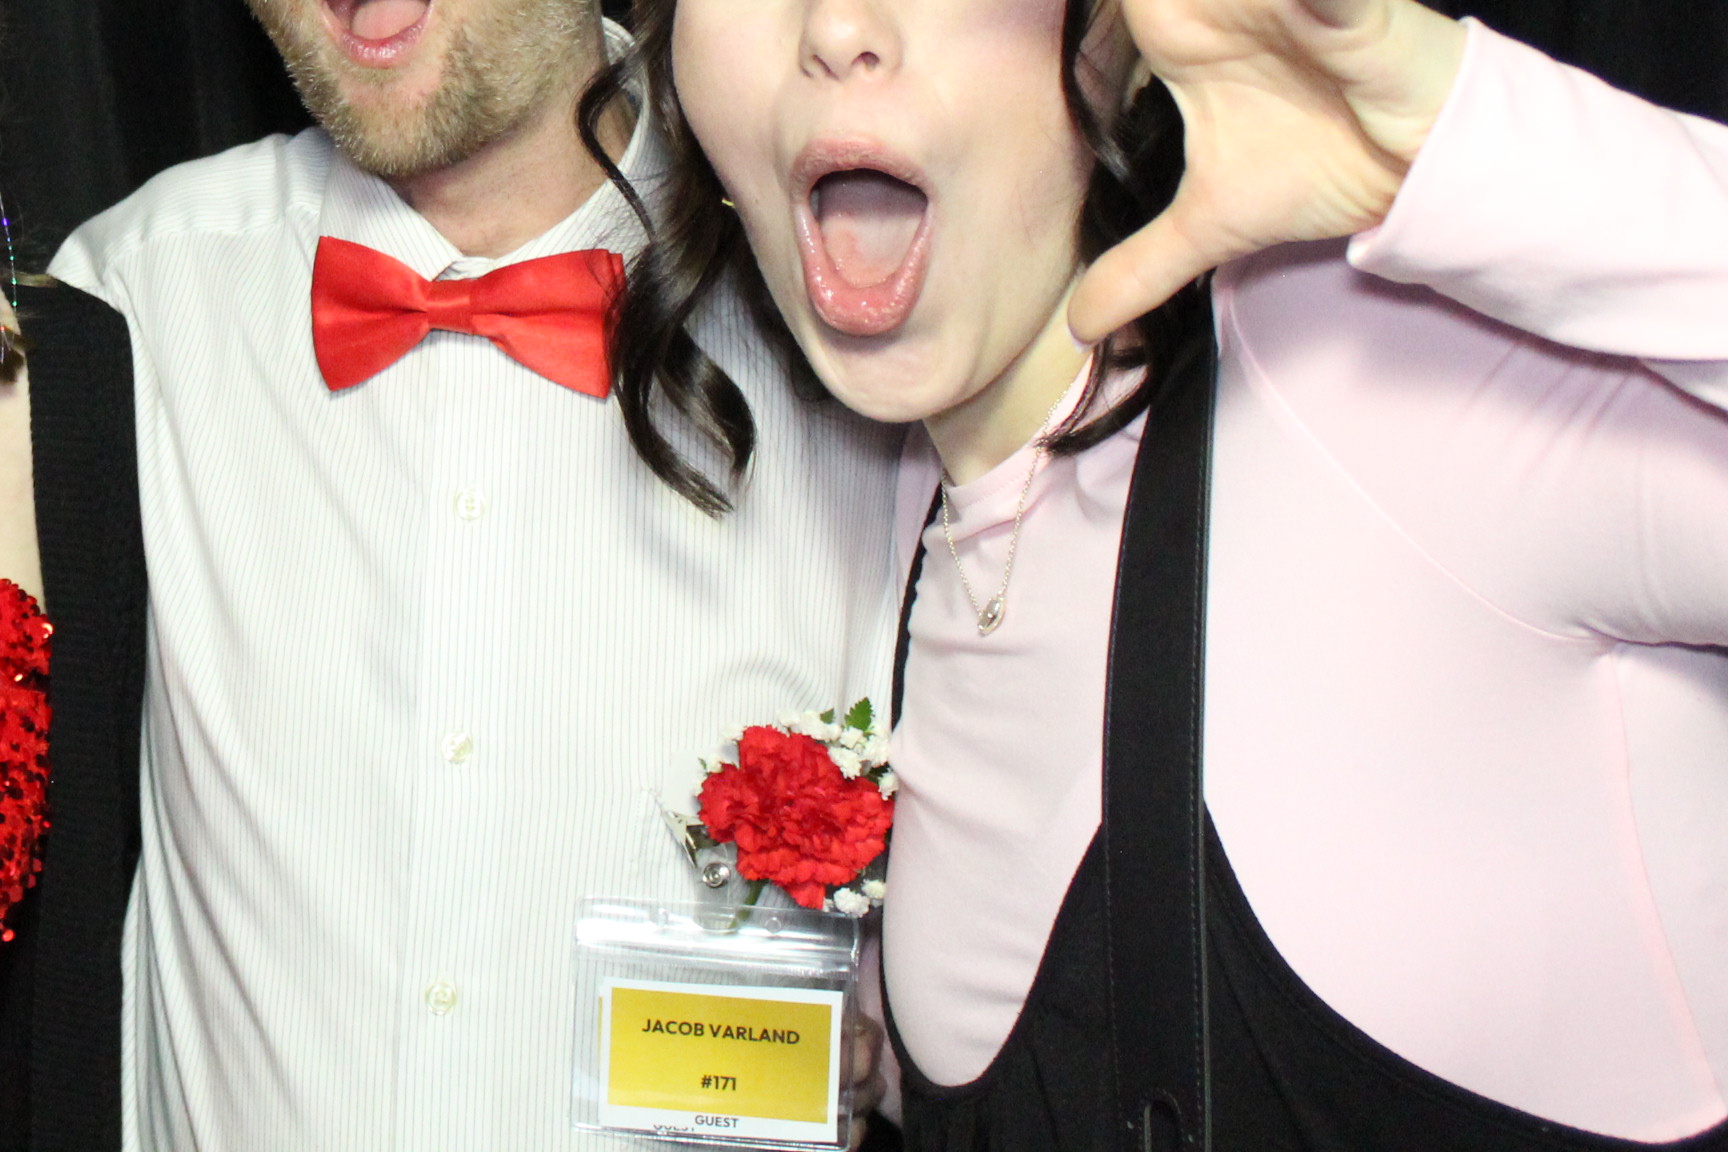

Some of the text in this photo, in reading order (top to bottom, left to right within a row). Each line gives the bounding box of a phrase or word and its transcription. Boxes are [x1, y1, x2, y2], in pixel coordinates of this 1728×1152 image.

[642, 1019, 800, 1045] JACOB VARLAND
[701, 1075, 737, 1091] #171
[694, 1114, 739, 1128] GUEST
